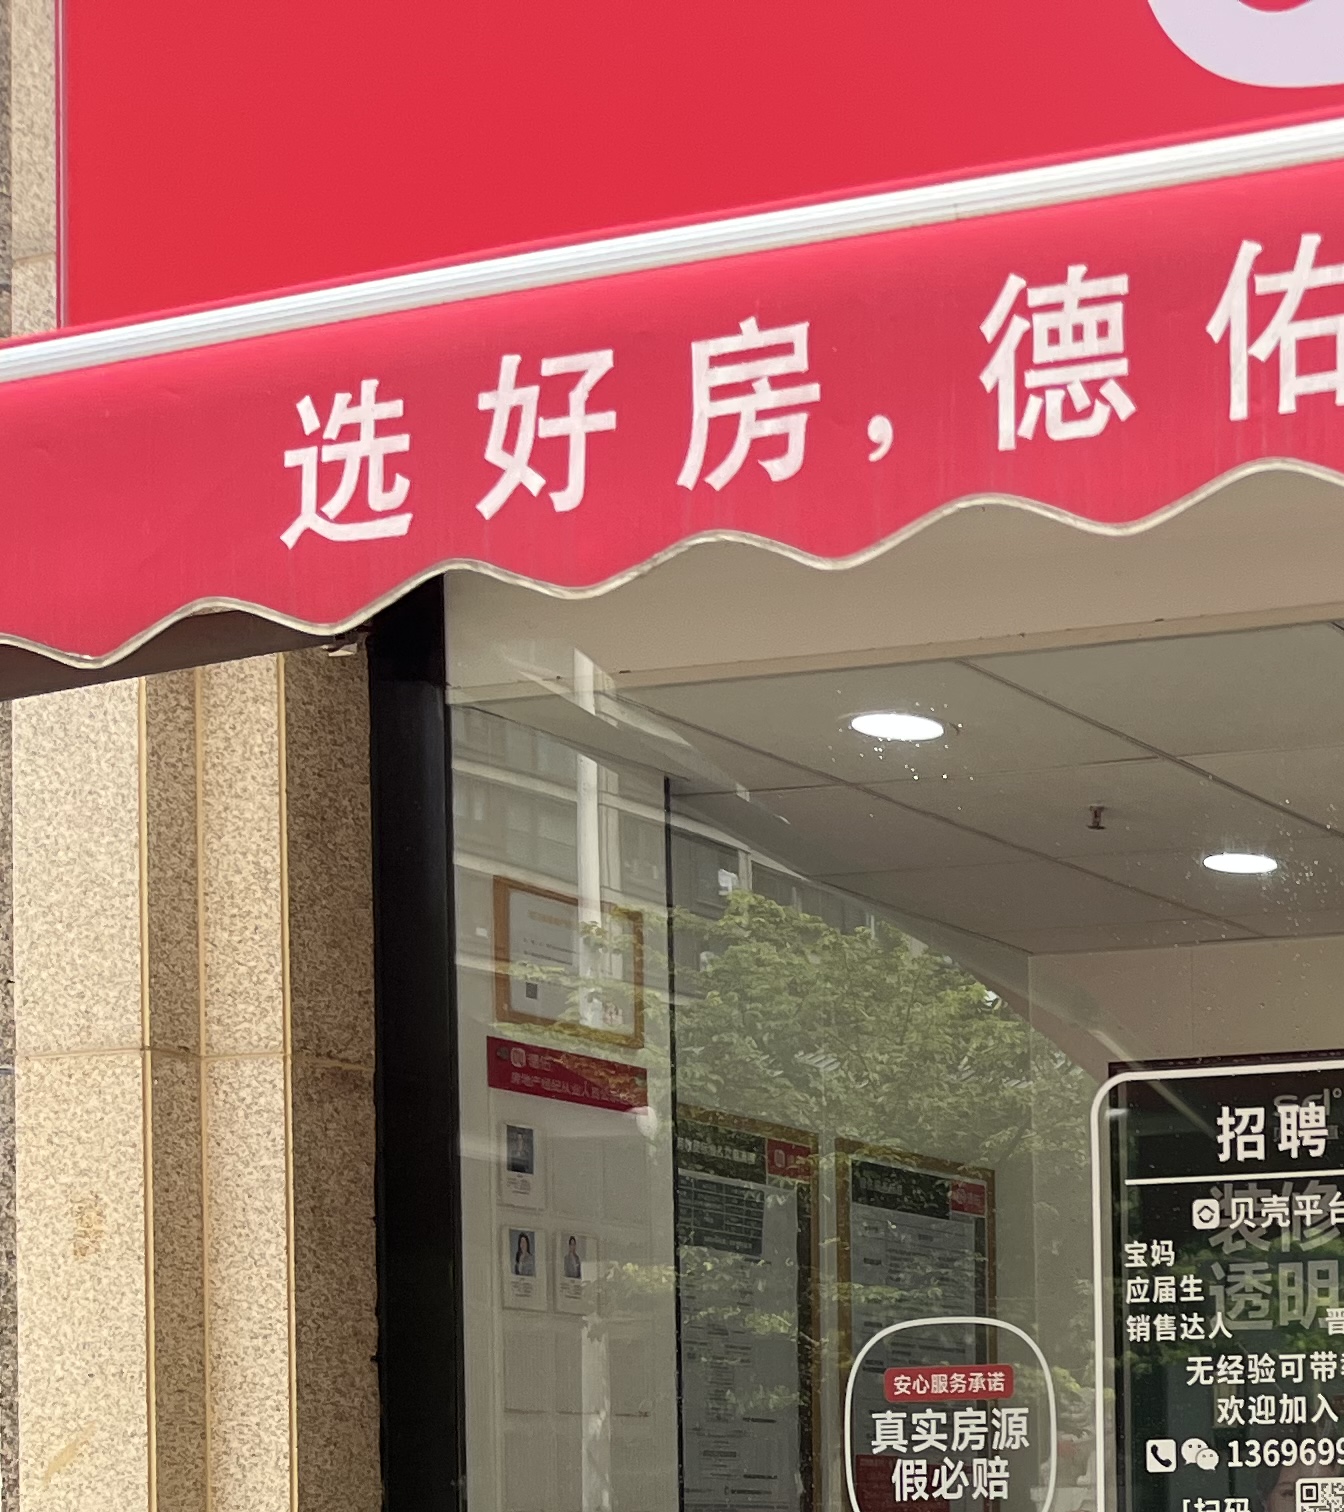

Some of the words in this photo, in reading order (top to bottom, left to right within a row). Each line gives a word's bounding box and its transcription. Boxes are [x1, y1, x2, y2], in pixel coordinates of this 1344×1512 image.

[1216, 1102, 1329, 1163] 招聘
[1123, 1239, 1176, 1269] 宝妈
[1125, 1275, 1205, 1305] 应届生
[1125, 1312, 1234, 1342] 销售达人
[892, 1371, 1007, 1397] 安心服务承诺
[1215, 1393, 1340, 1426] 欢迎加入
[870, 1406, 1031, 1454] 真实房源
[891, 1456, 1010, 1503] 假必赔
